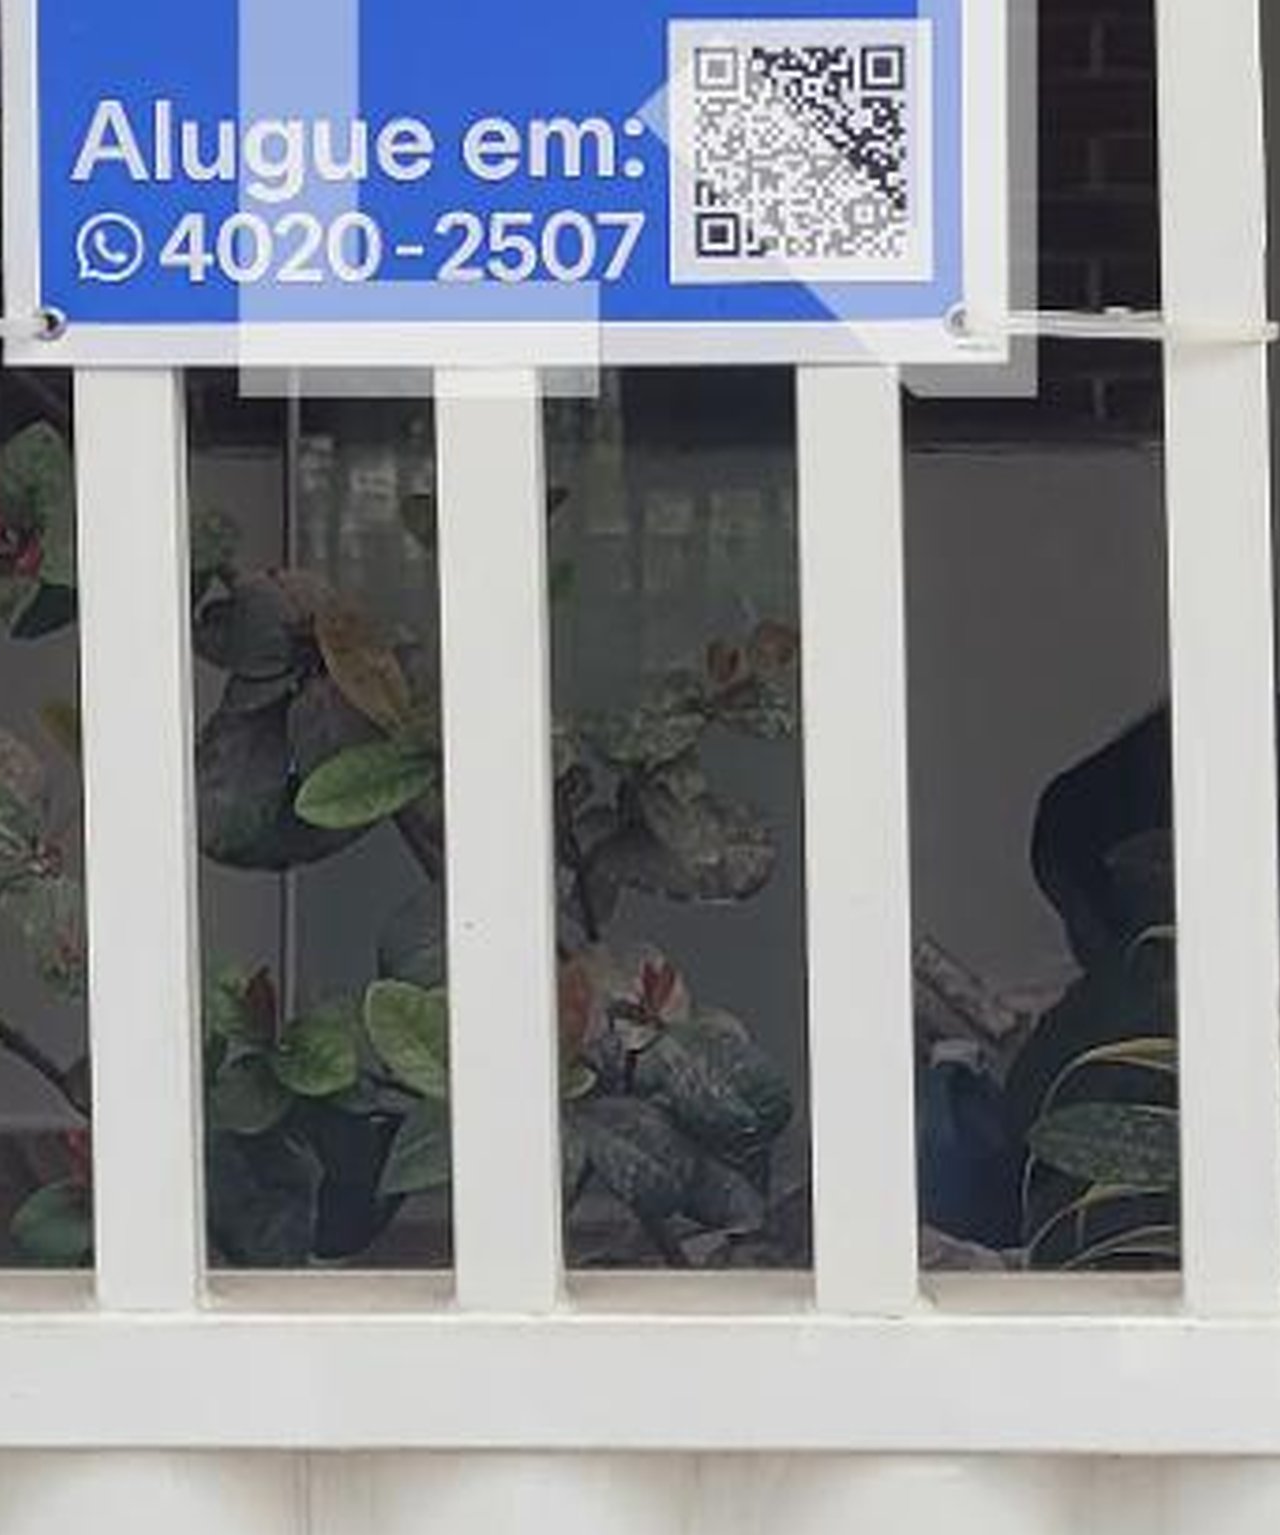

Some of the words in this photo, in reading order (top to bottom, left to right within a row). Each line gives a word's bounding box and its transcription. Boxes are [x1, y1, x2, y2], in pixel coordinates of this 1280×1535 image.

[70, 98, 435, 203] Alugue
[462, 114, 646, 180] em:
[158, 210, 646, 283] 4020-2507
